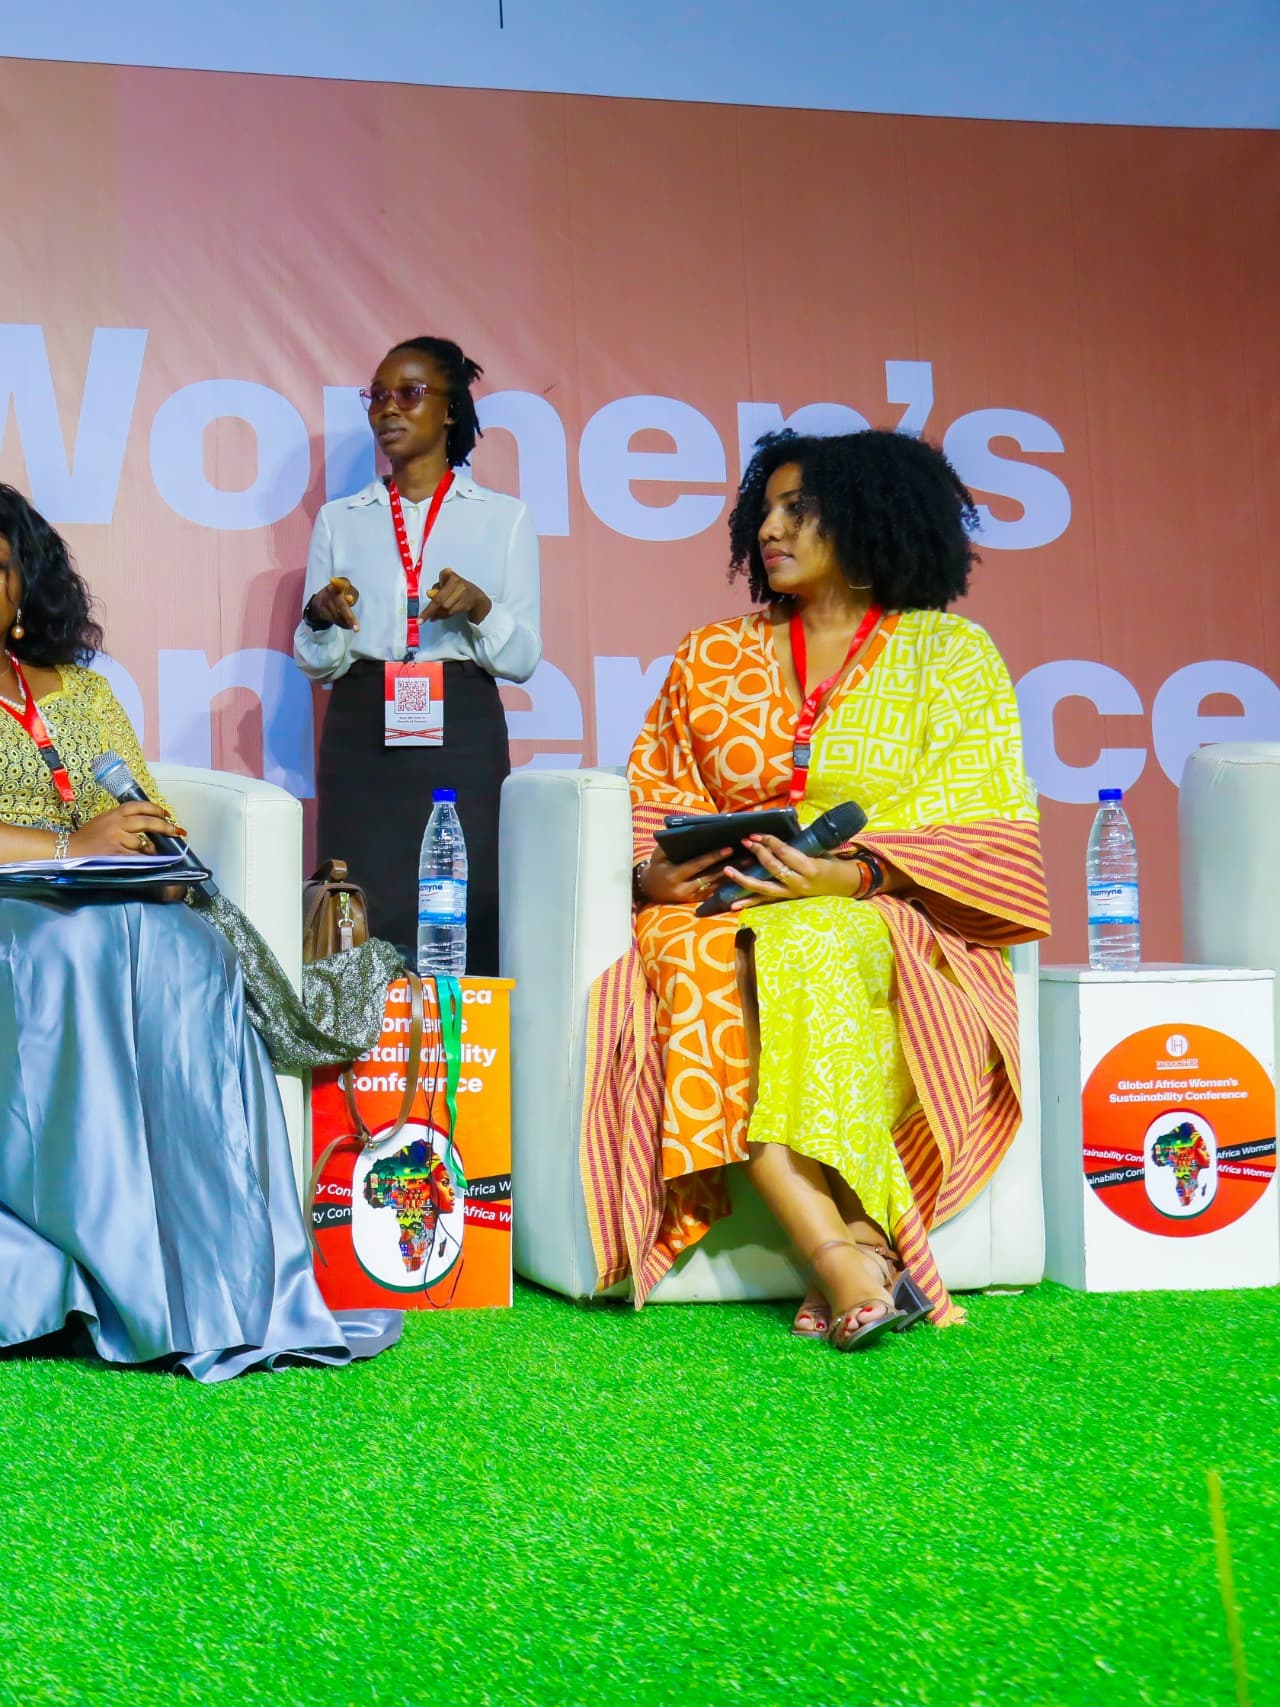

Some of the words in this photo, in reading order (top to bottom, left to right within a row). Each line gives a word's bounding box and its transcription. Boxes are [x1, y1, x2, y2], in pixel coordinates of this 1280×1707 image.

[1118, 1081, 1153, 1090] Global
[1155, 1079, 1187, 1089] Africa
[1189, 1077, 1239, 1088] Women's
[1109, 1092, 1183, 1103] Sustainability
[1185, 1090, 1248, 1101] Conference
[1216, 1149, 1241, 1159] Africa
[1217, 1164, 1242, 1175] Africa
[463, 1183, 496, 1197] Africa
[464, 1205, 496, 1221] Africa
